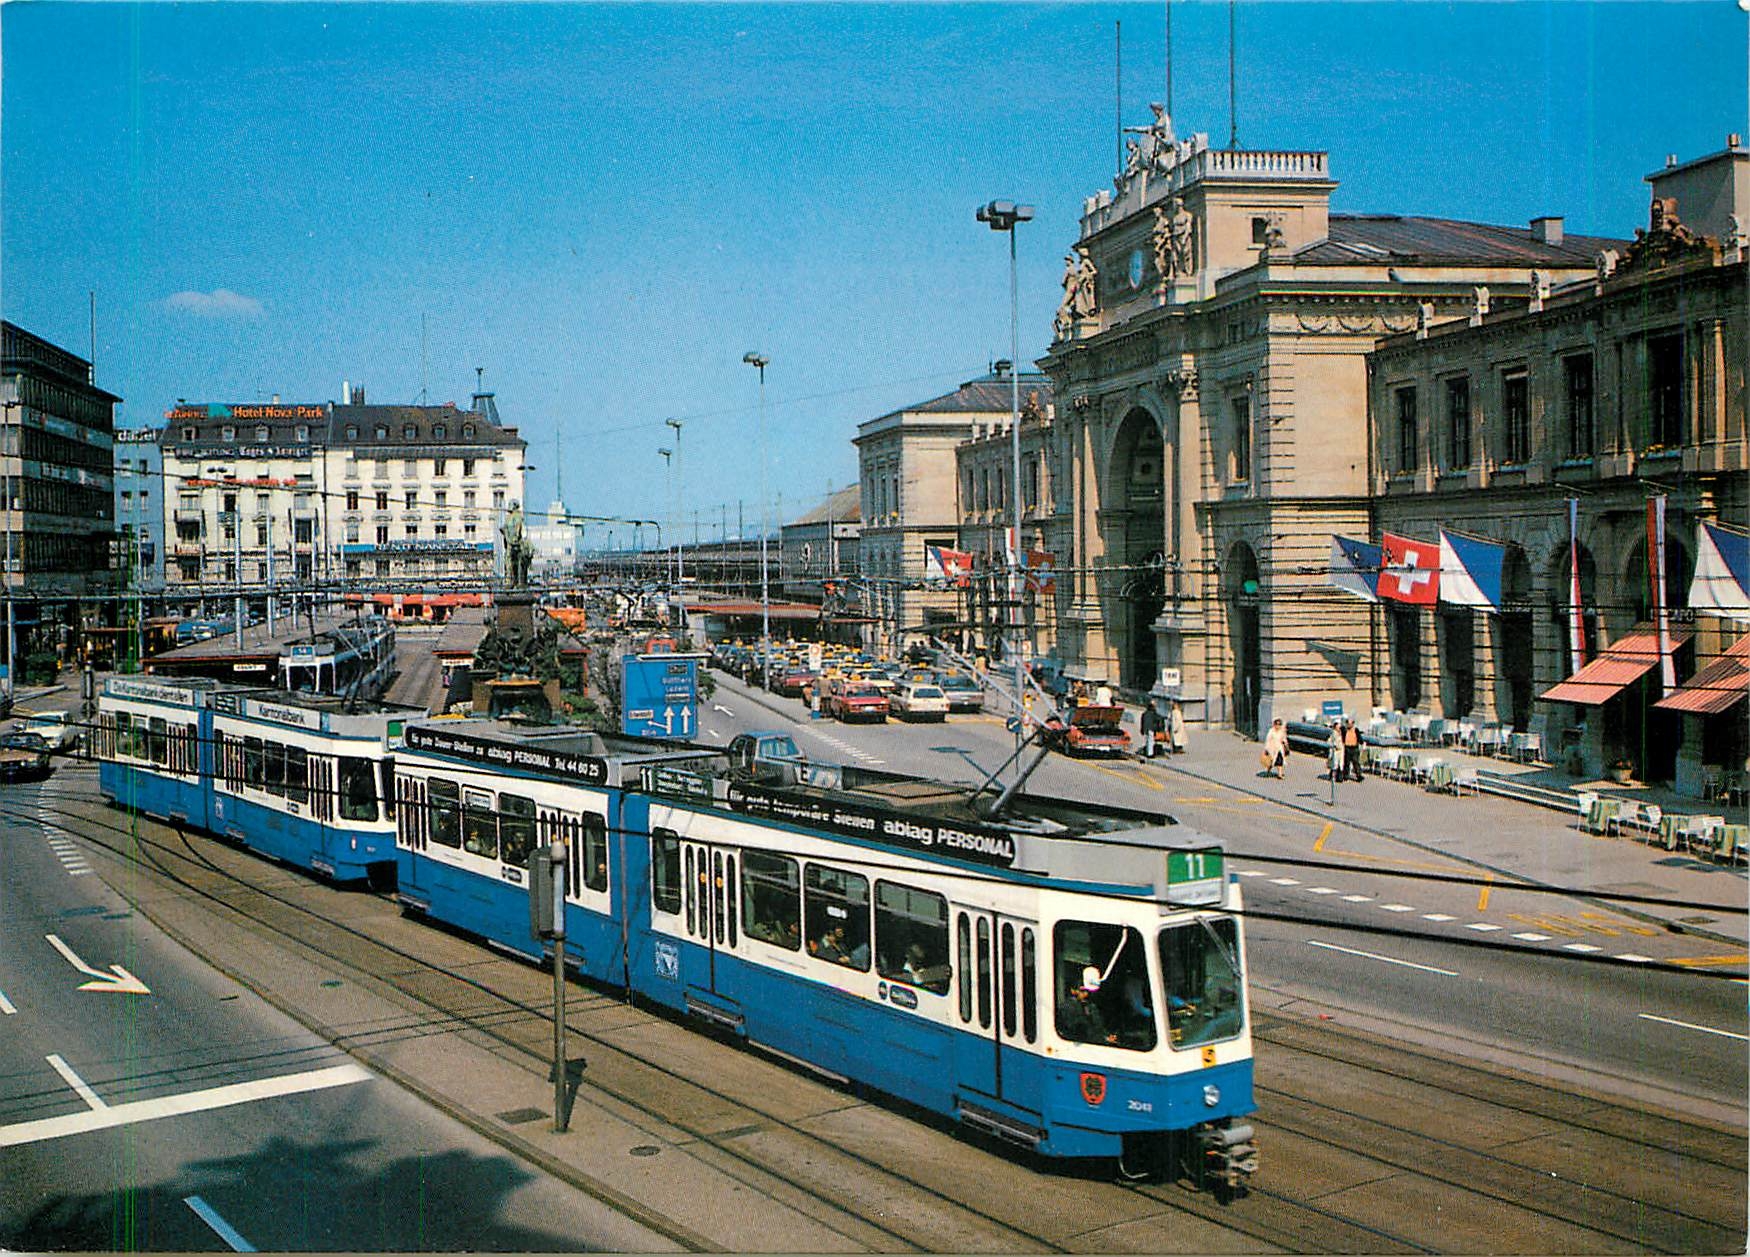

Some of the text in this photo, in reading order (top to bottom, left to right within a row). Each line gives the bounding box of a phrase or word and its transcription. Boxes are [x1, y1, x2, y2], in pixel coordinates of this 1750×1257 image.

[234, 405, 323, 418] Hotel Nova Park
[259, 703, 306, 725] Kantonalbank
[514, 750, 550, 767] PERSONAL
[588, 765, 599, 776] 25
[641, 767, 653, 792] 11
[937, 828, 1013, 858] PERSONAL
[1185, 854, 1205, 879] 11
